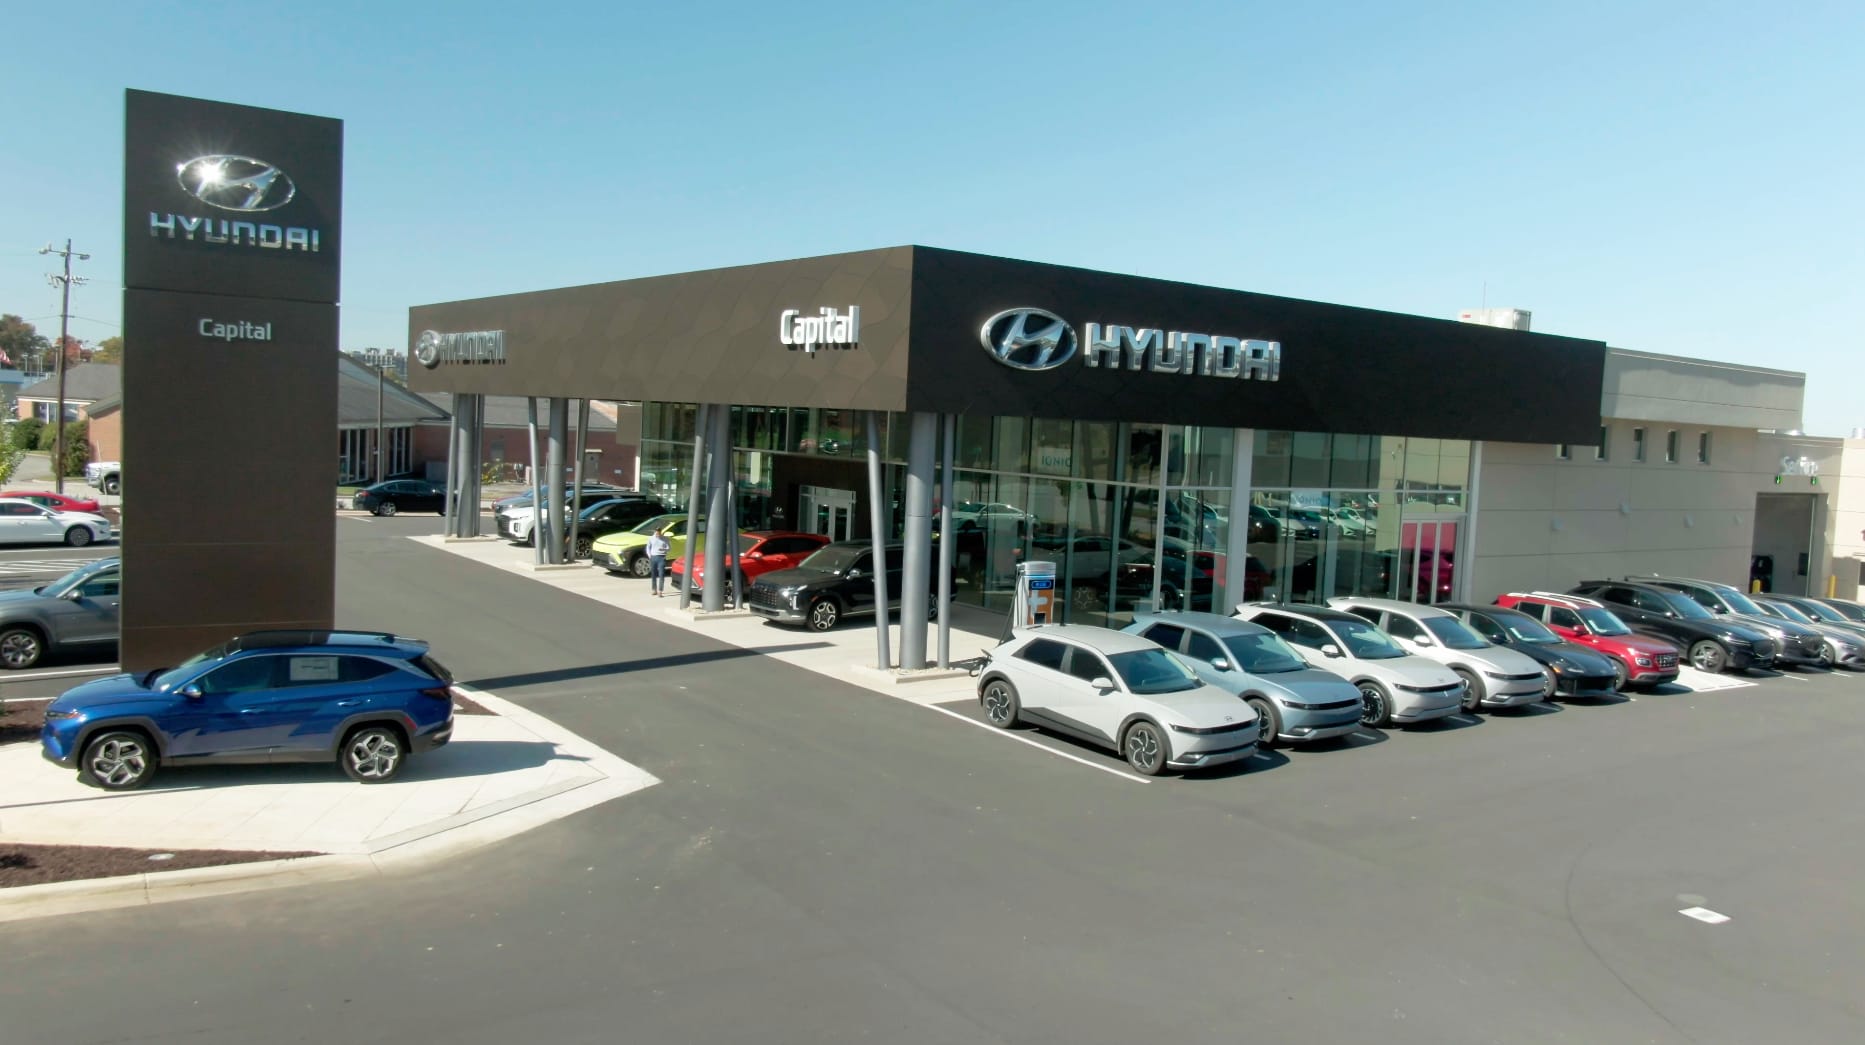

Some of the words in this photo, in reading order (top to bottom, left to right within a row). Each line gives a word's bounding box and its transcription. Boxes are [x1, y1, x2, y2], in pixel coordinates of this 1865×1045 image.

[150, 211, 320, 252] HYUNDAI
[198, 318, 272, 342] Capital
[779, 305, 860, 353] Capital
[1085, 322, 1281, 382] HYUNDAI
